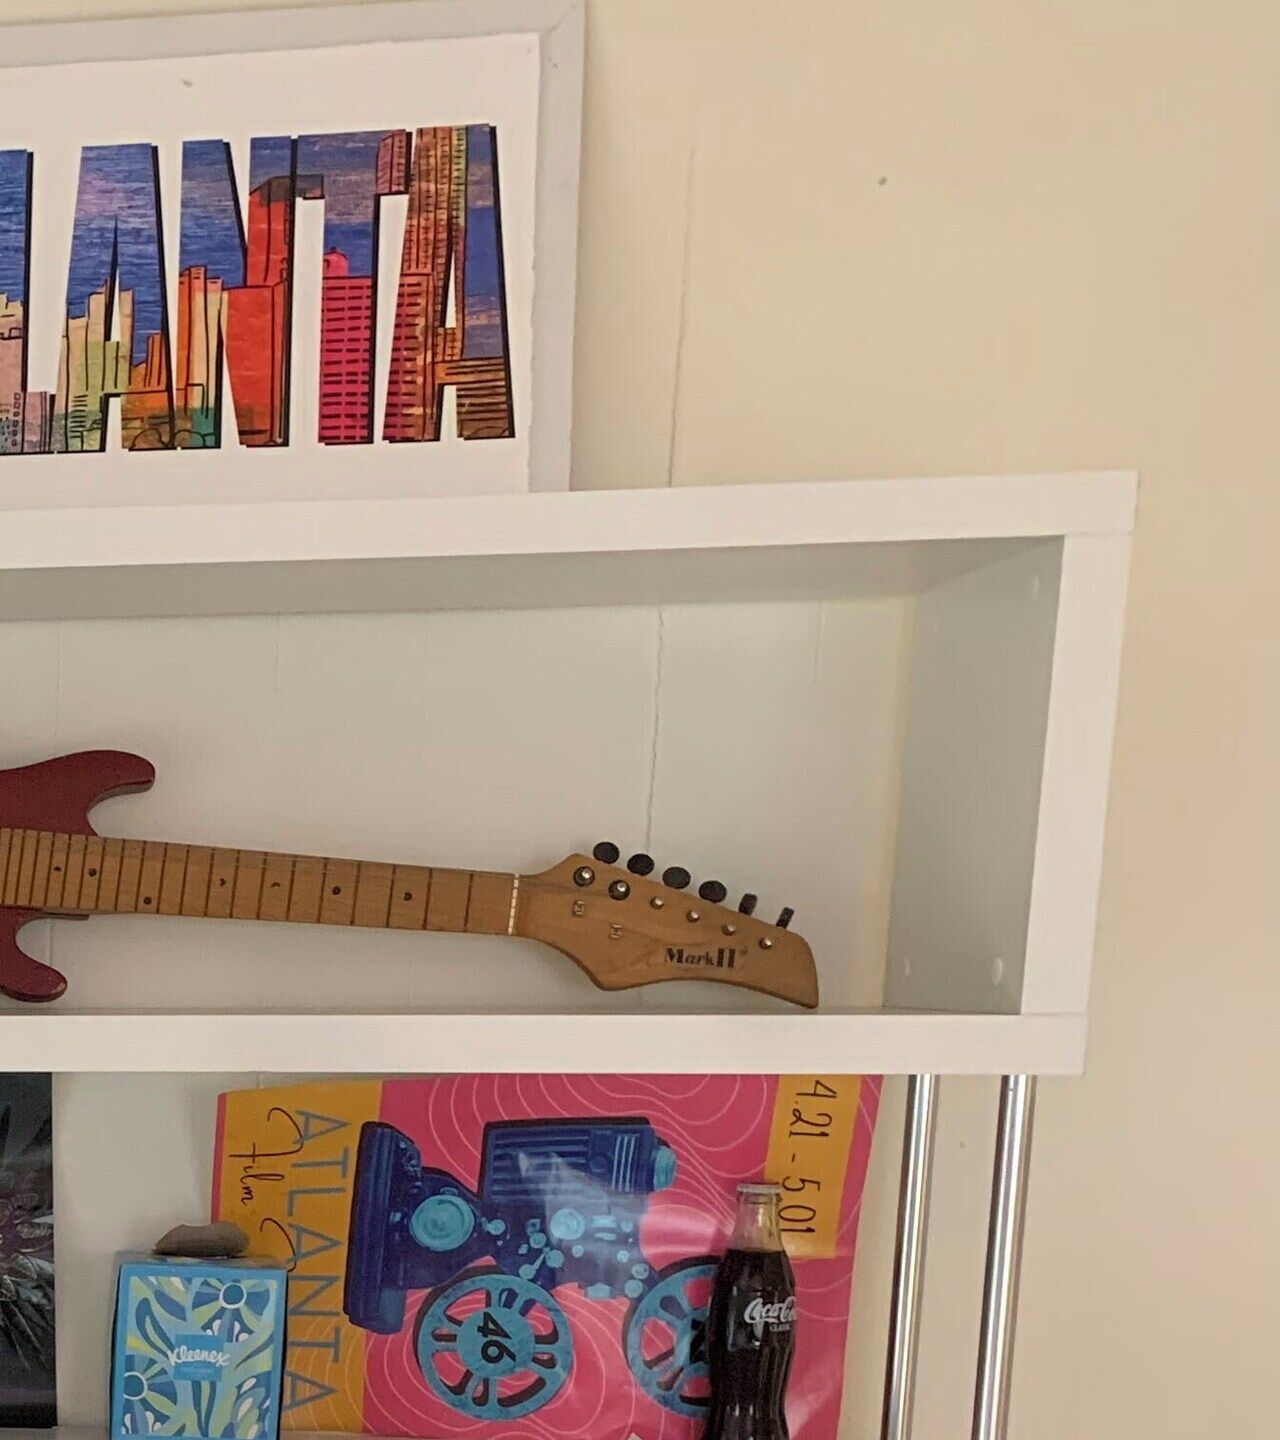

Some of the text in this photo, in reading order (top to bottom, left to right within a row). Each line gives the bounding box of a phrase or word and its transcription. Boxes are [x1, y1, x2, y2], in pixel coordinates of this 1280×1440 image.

[788, 1080, 838, 1138] 4.21
[228, 1107, 304, 1207] Film
[283, 1108, 351, 1411] ATLANTA
[167, 1344, 230, 1367] Kleenex
[477, 1312, 516, 1363] 46
